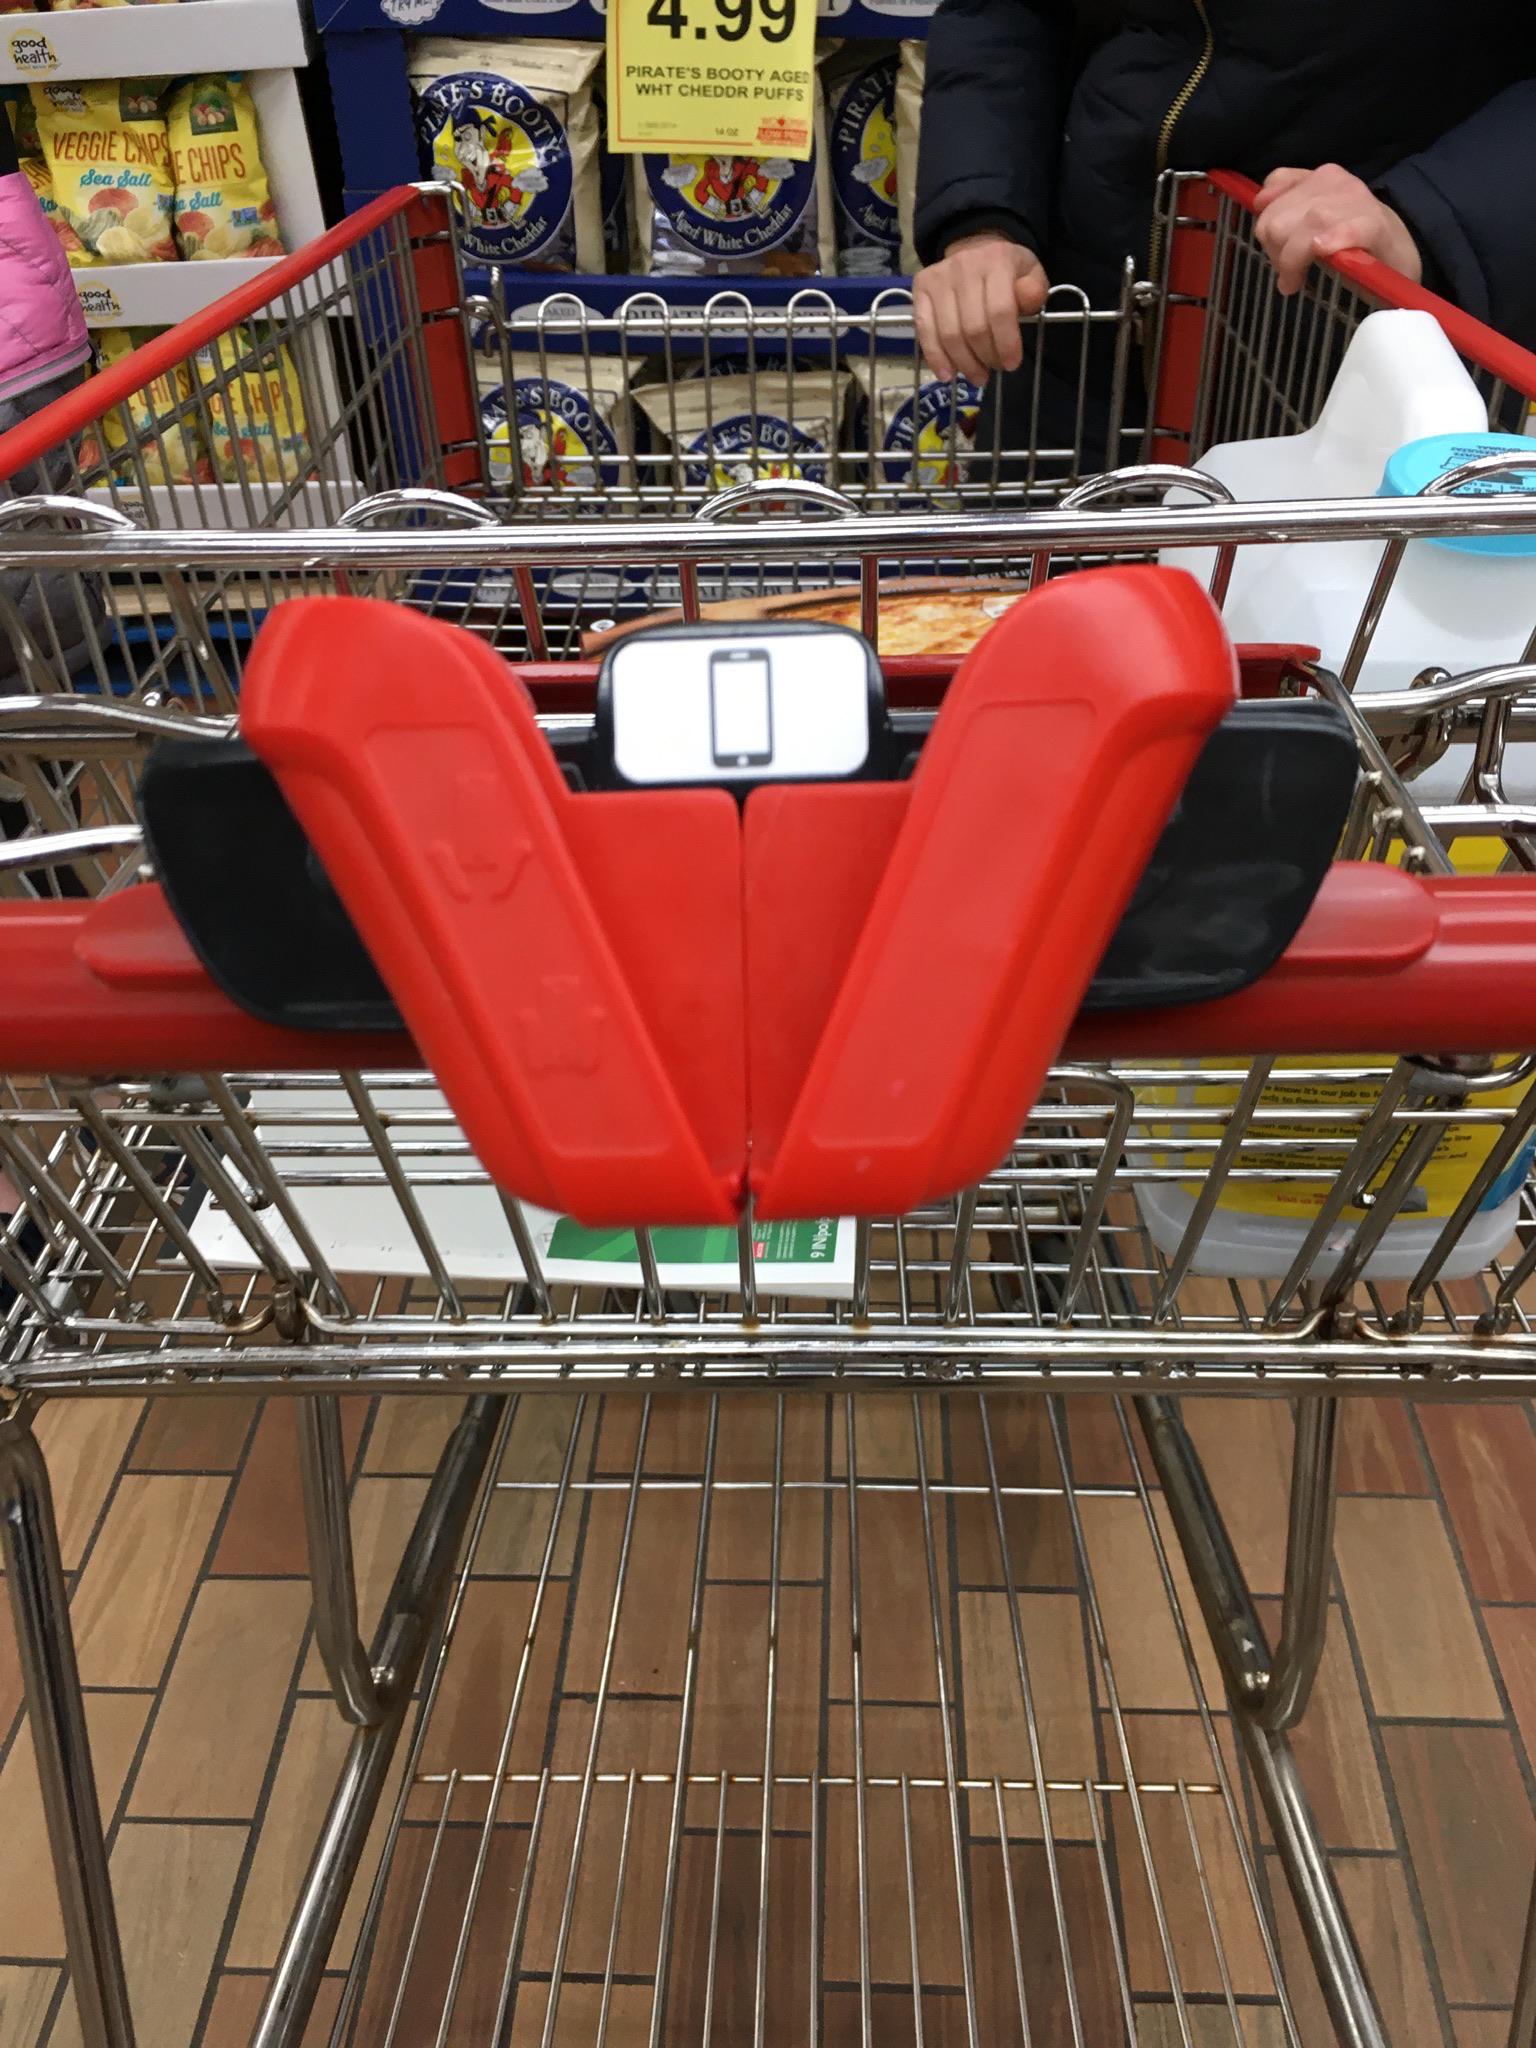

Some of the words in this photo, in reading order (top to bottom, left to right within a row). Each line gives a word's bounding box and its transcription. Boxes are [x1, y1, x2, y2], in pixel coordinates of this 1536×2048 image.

[647, 0, 796, 43] 4.99
[12, 37, 47, 53] good
[13, 49, 57, 64] health
[626, 65, 701, 80] PIRATE'S
[706, 67, 765, 81] BOOTY
[635, 83, 673, 97] WHT
[678, 83, 749, 99] CHEDDR
[753, 86, 805, 102] PUFFS
[52, 130, 118, 161] VEGGIE
[187, 143, 246, 183] CHIPS
[79, 168, 114, 188] Sea
[115, 169, 153, 188] Salt
[189, 191, 223, 211] Salt
[701, 227, 744, 250] White
[743, 203, 794, 248] Cheddar
